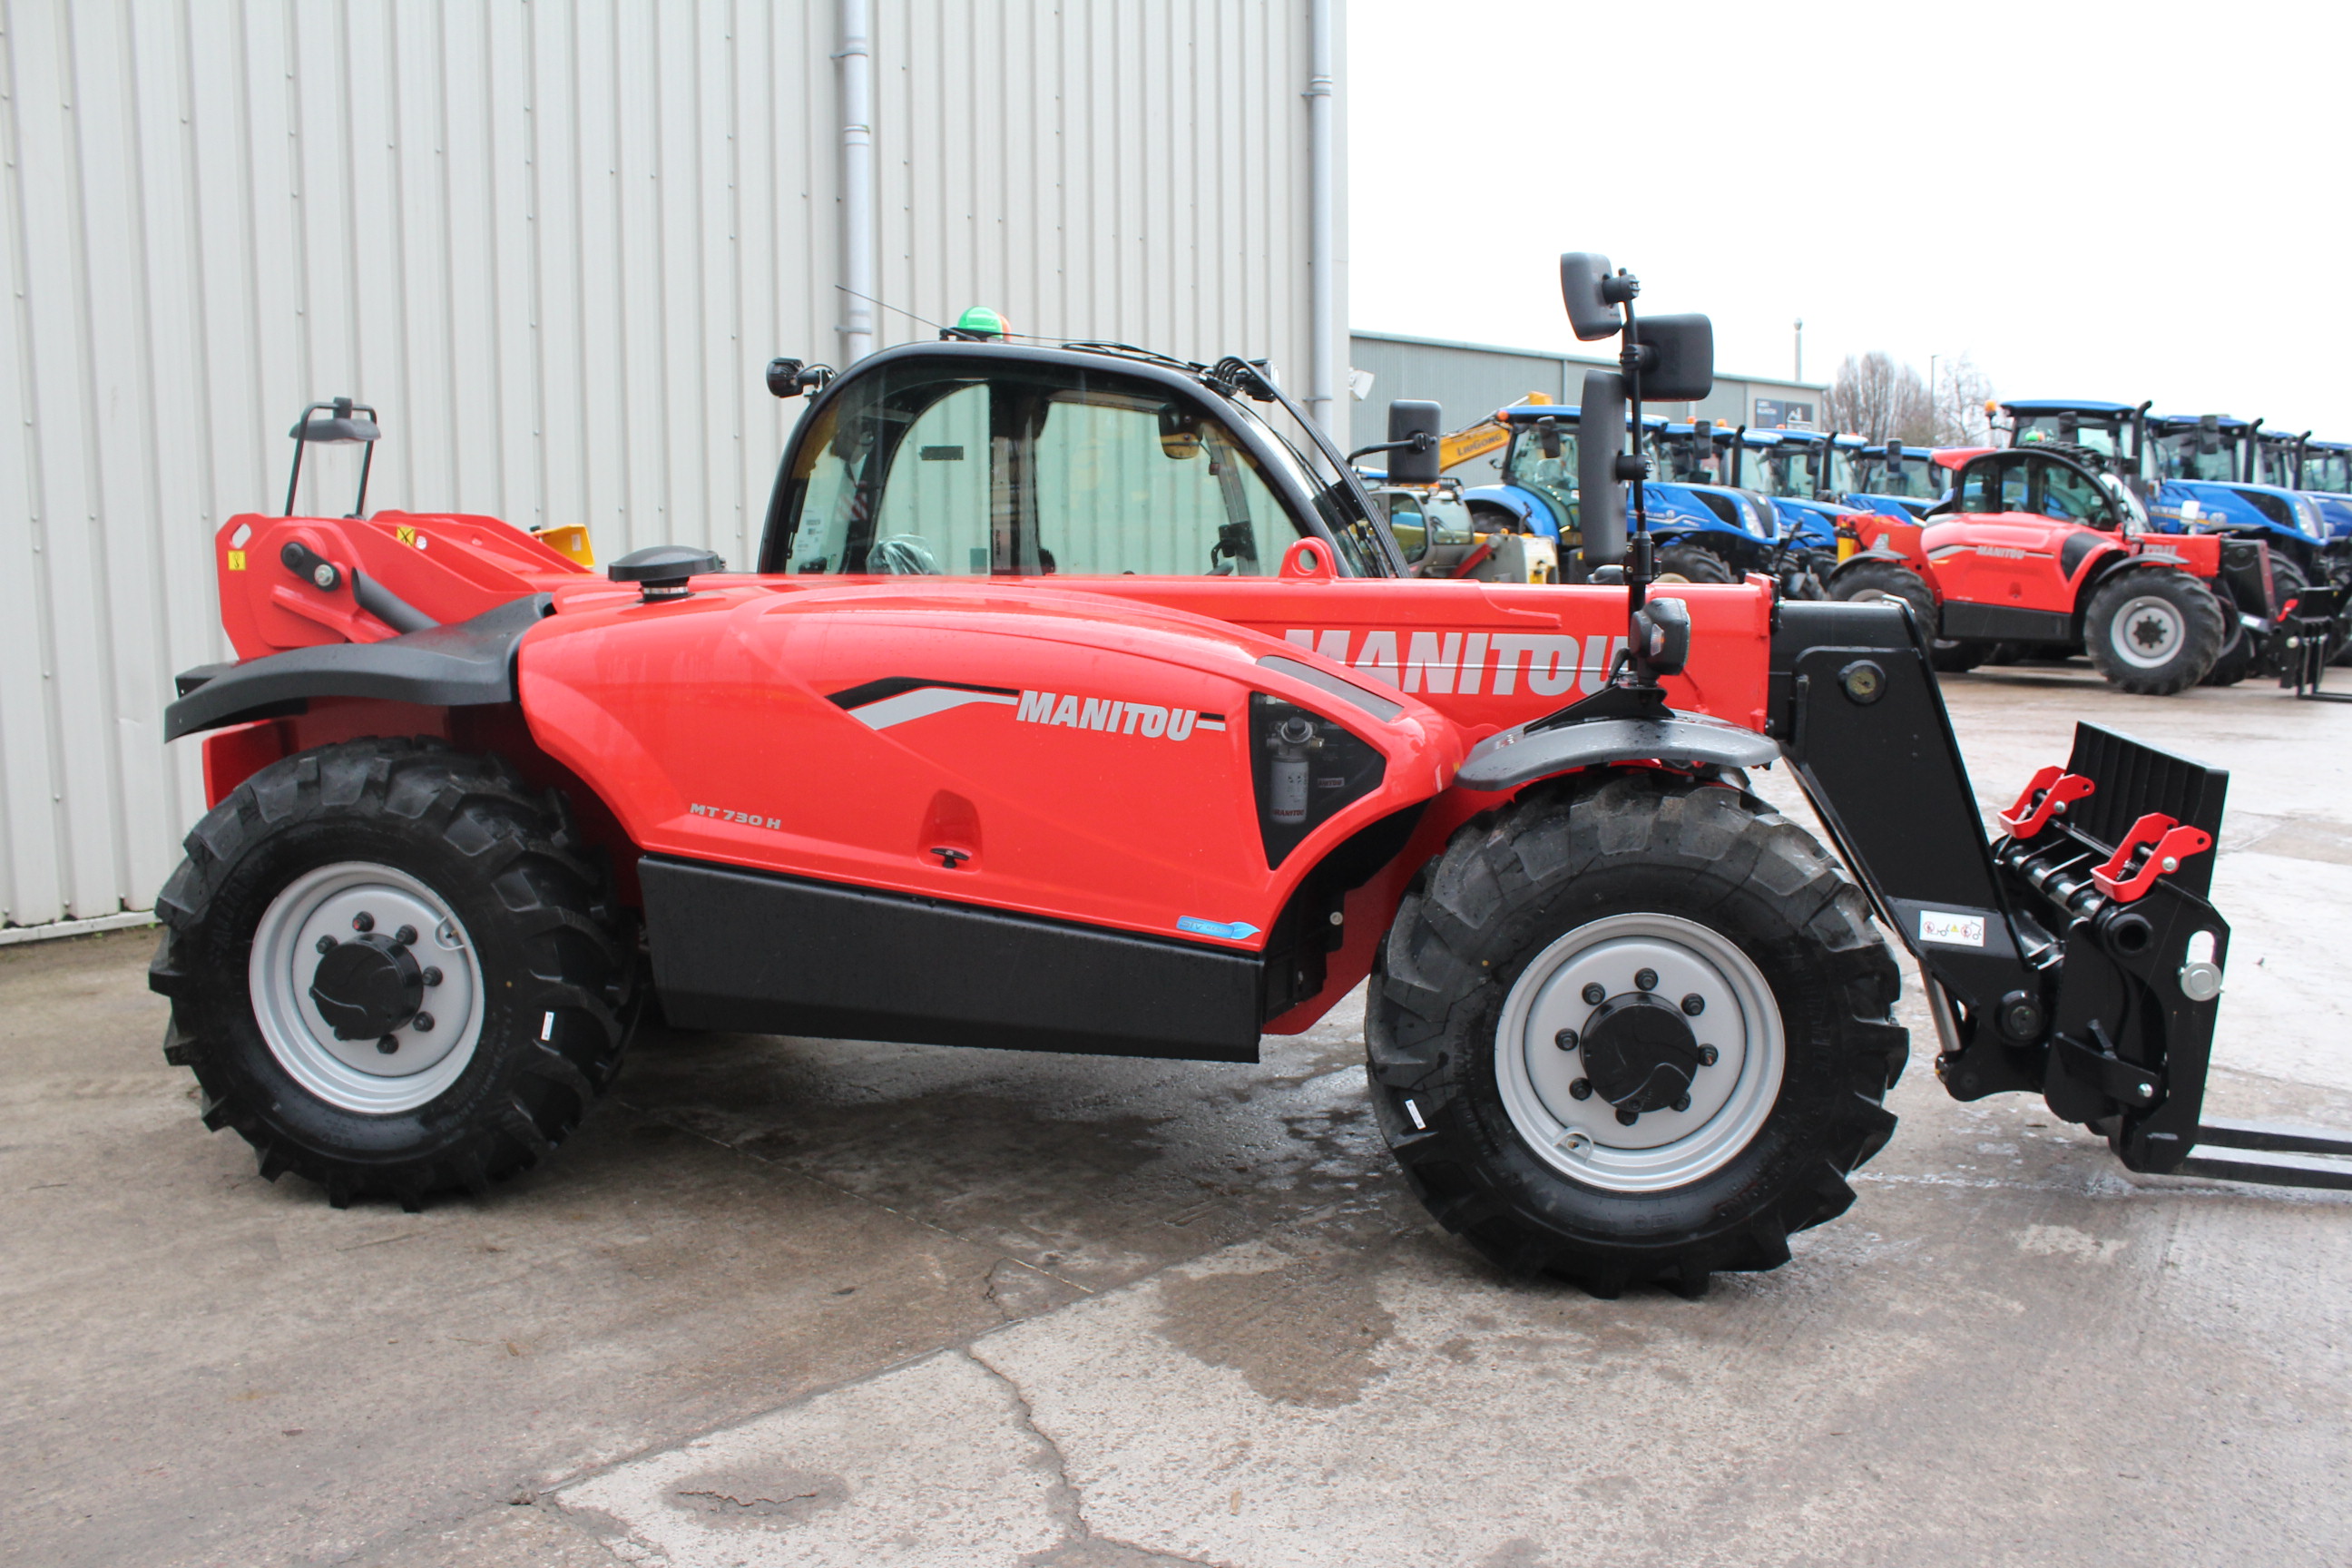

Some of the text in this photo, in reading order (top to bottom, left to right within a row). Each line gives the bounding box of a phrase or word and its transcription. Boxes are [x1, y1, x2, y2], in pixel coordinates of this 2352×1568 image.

[1976, 545, 2026, 560] MANITOU
[1015, 689, 1197, 741] MANITOU
[690, 803, 781, 830] MT 730 H
